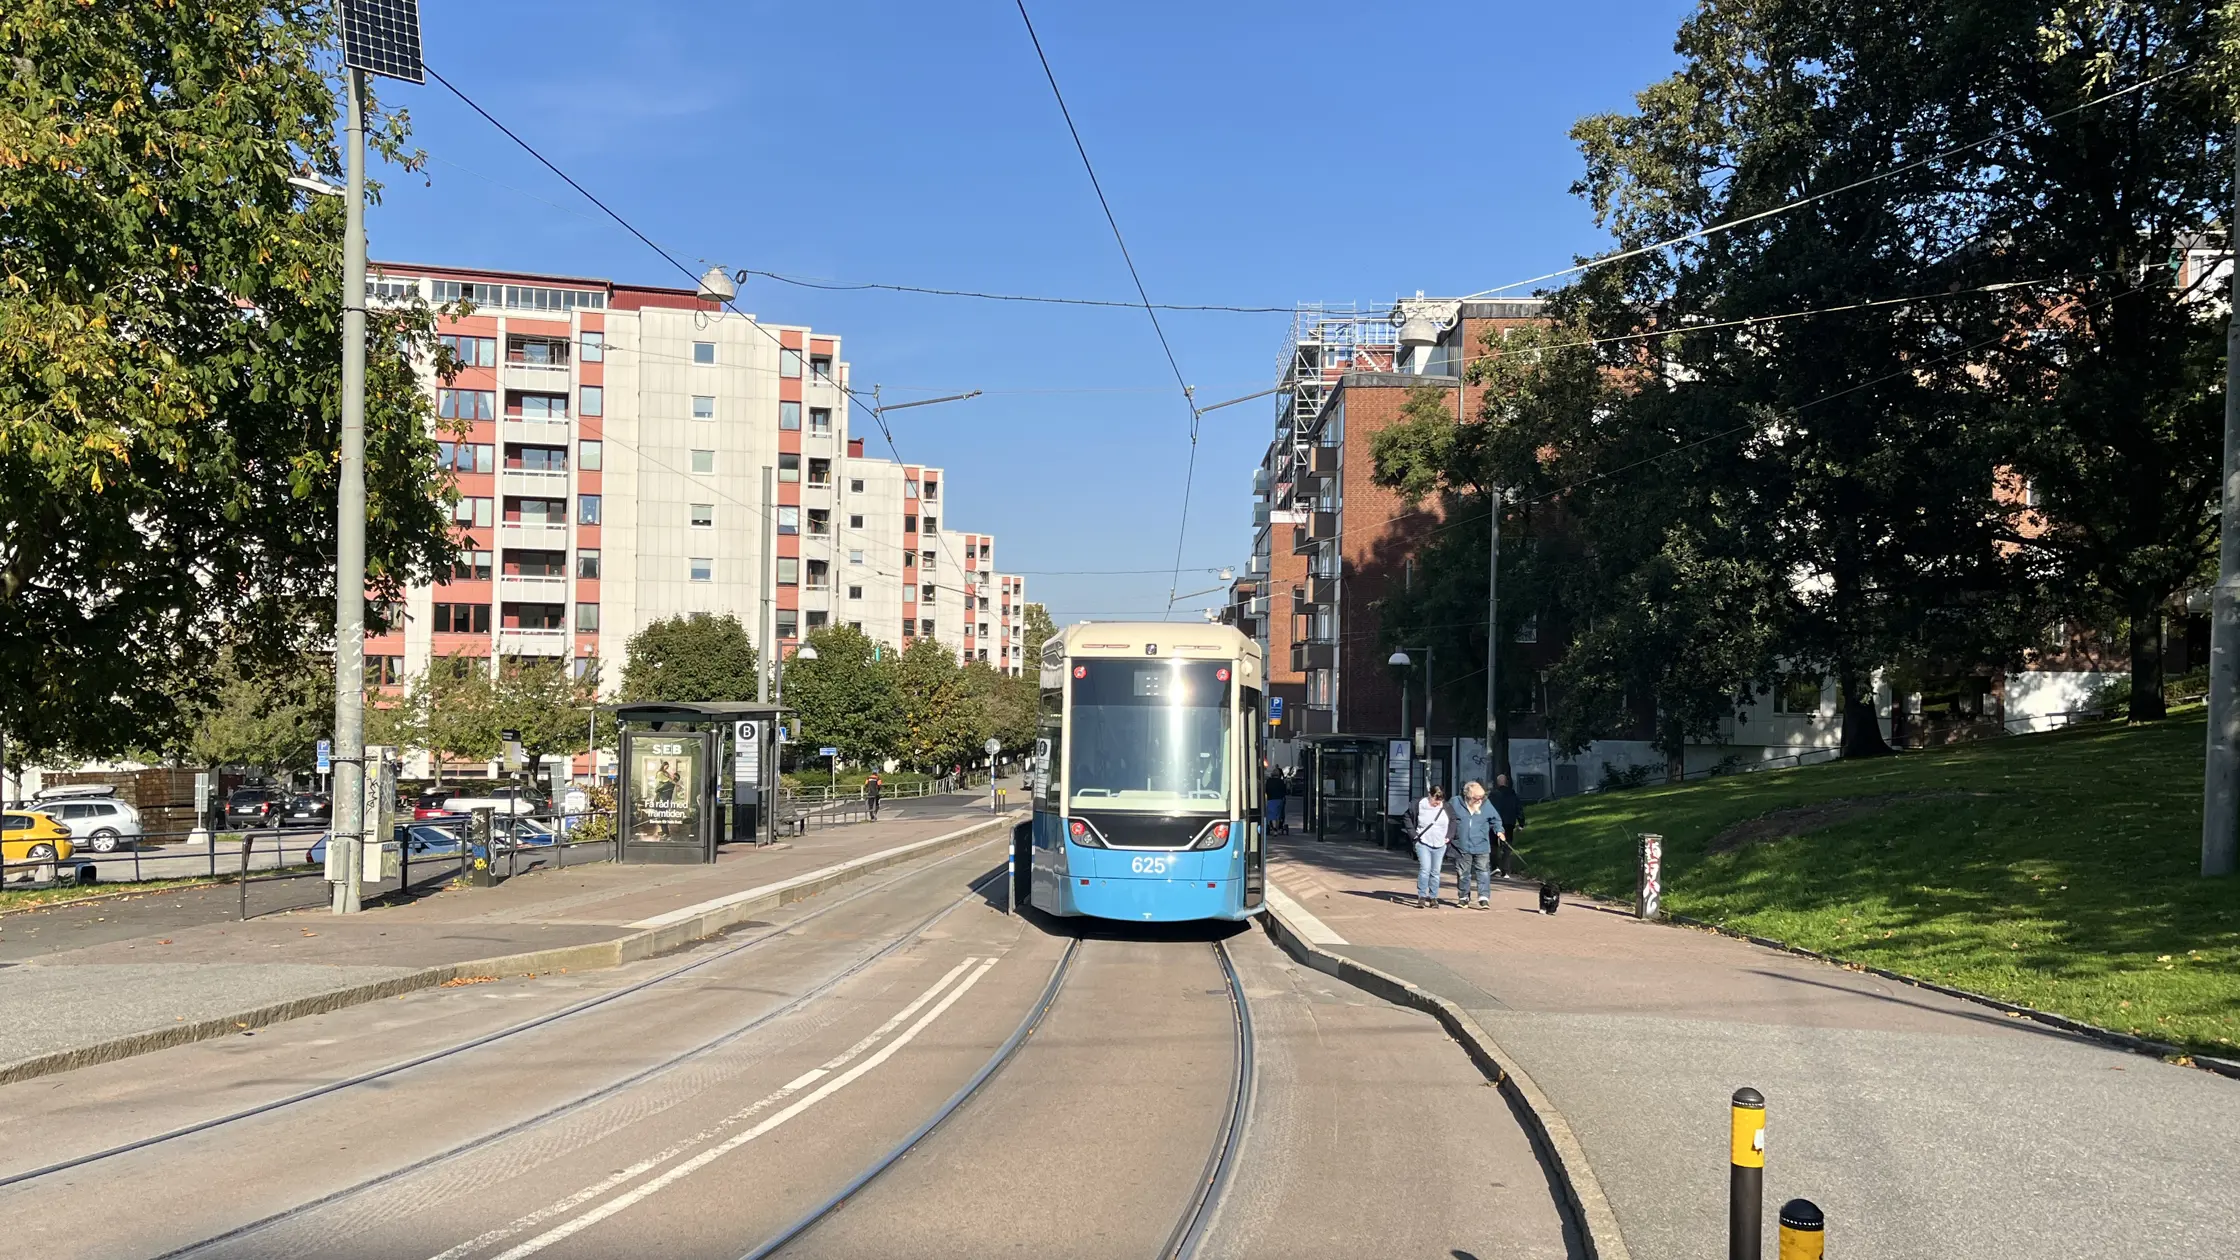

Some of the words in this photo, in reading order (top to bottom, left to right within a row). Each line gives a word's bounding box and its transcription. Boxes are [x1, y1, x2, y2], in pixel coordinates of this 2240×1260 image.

[743, 725, 752, 738] B
[652, 744, 682, 755] SEB
[1395, 743, 1404, 757] A
[644, 798, 655, 808] Få
[655, 798, 669, 808] råd
[670, 799, 688, 808] med
[647, 809, 687, 818] framtiden.
[1132, 857, 1166, 873] 625
